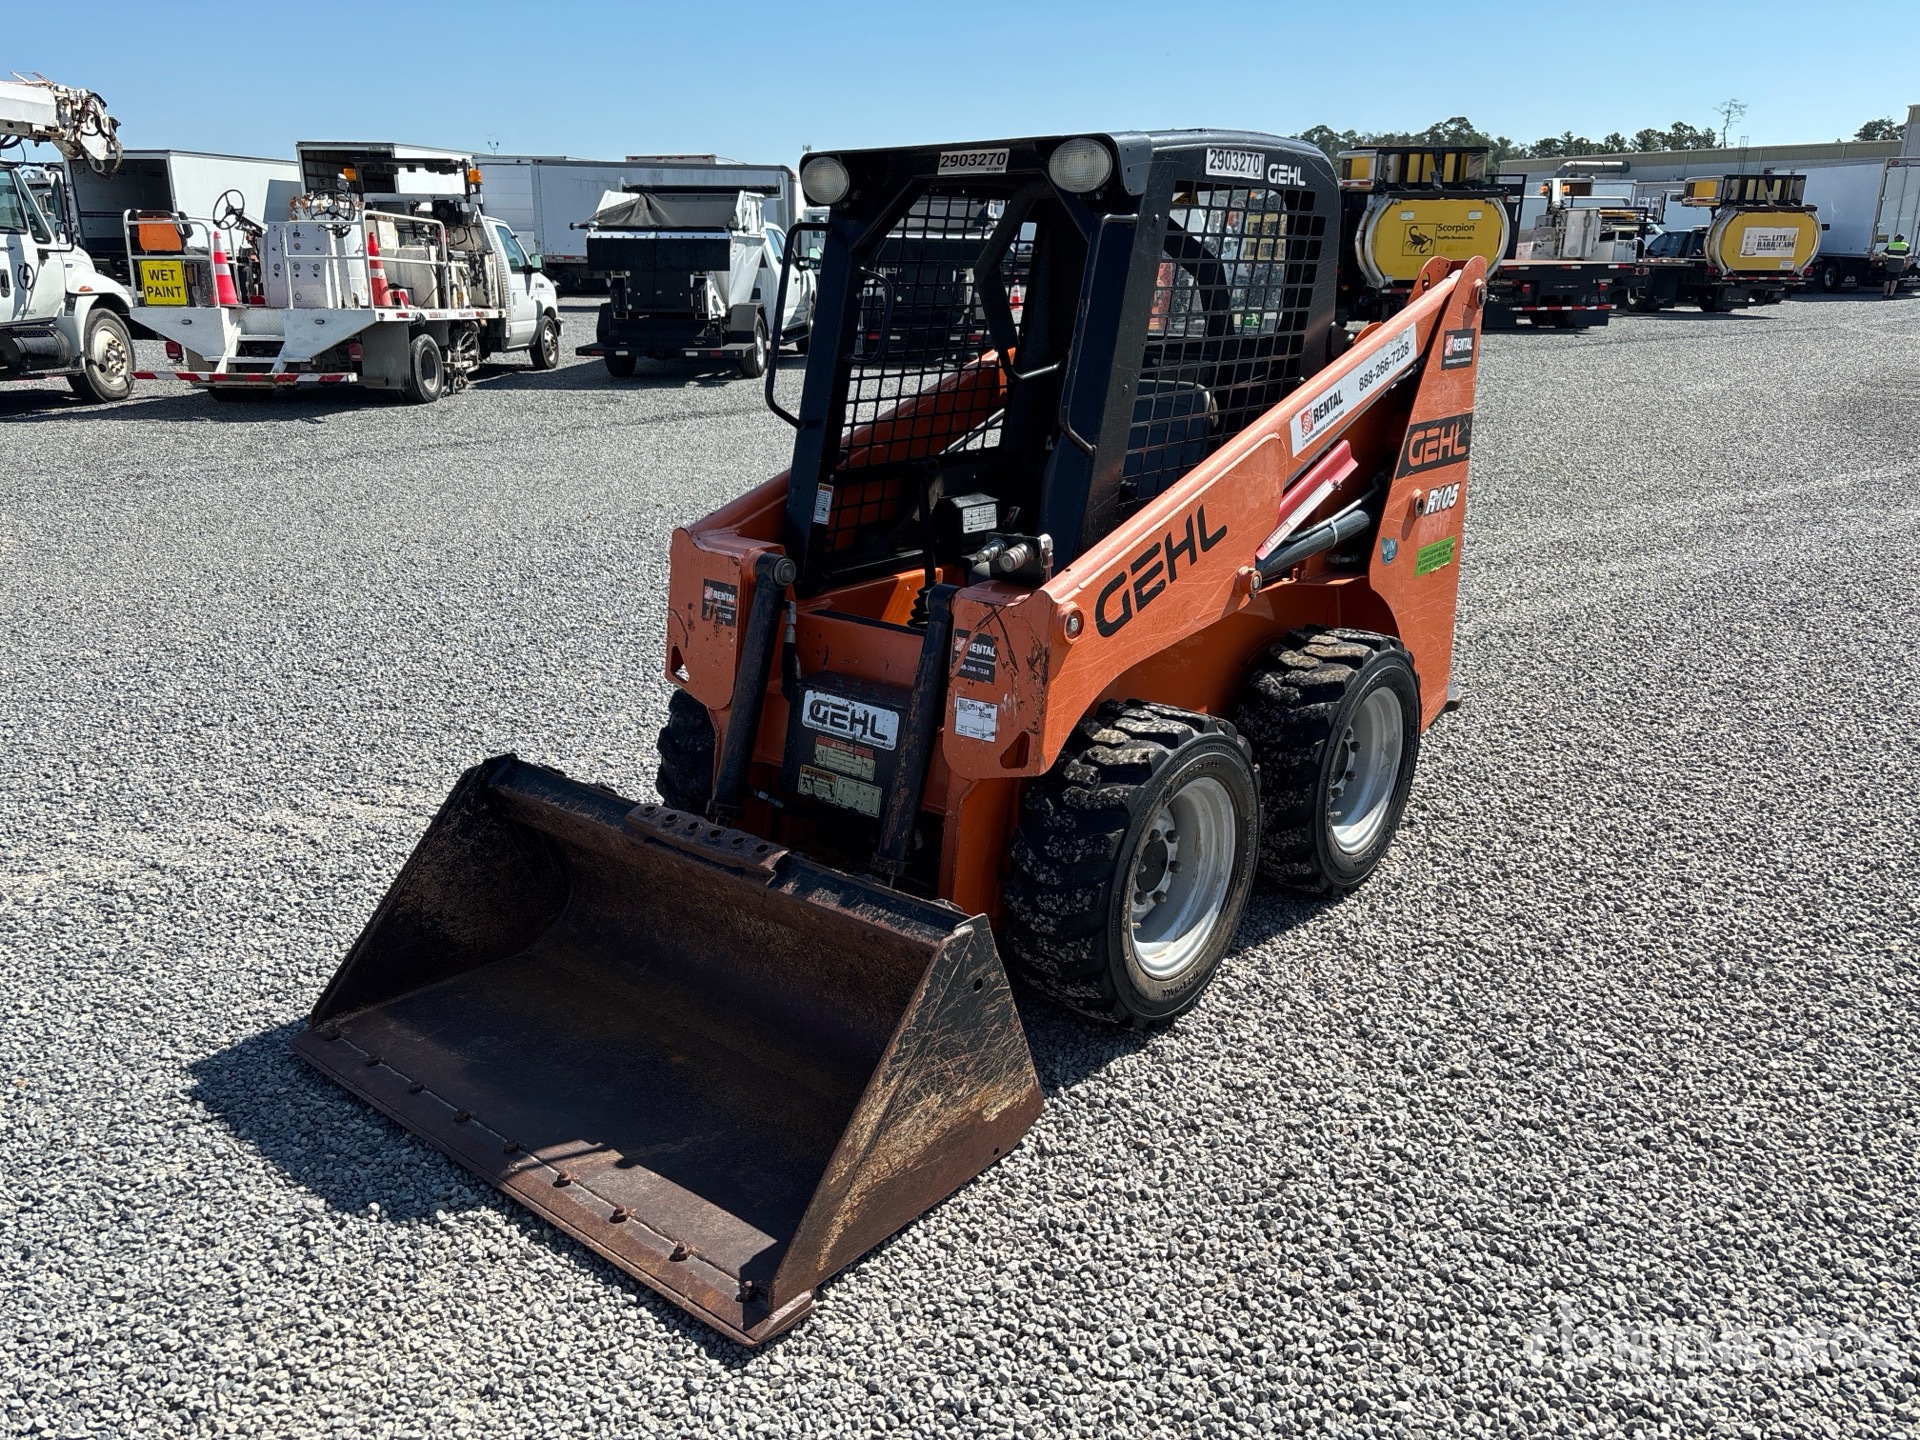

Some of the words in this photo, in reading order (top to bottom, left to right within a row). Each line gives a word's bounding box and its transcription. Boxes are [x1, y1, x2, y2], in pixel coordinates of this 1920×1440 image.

[940, 152, 1007, 167] 2903270
[1209, 149, 1260, 174] 2903270
[1267, 163, 1307, 186] GEHL
[1437, 223, 1475, 233] Scorpion
[148, 269, 176, 281] WET
[146, 286, 181, 298] PAINT
[1453, 337, 1473, 351] RENTAL
[1358, 341, 1410, 391] 888-266-7228
[1313, 389, 1344, 424] RENTAL
[1408, 424, 1467, 467] GEHL
[1424, 482, 1461, 515] R105
[1095, 504, 1227, 638] GEHL
[809, 699, 889, 742] GEHL
